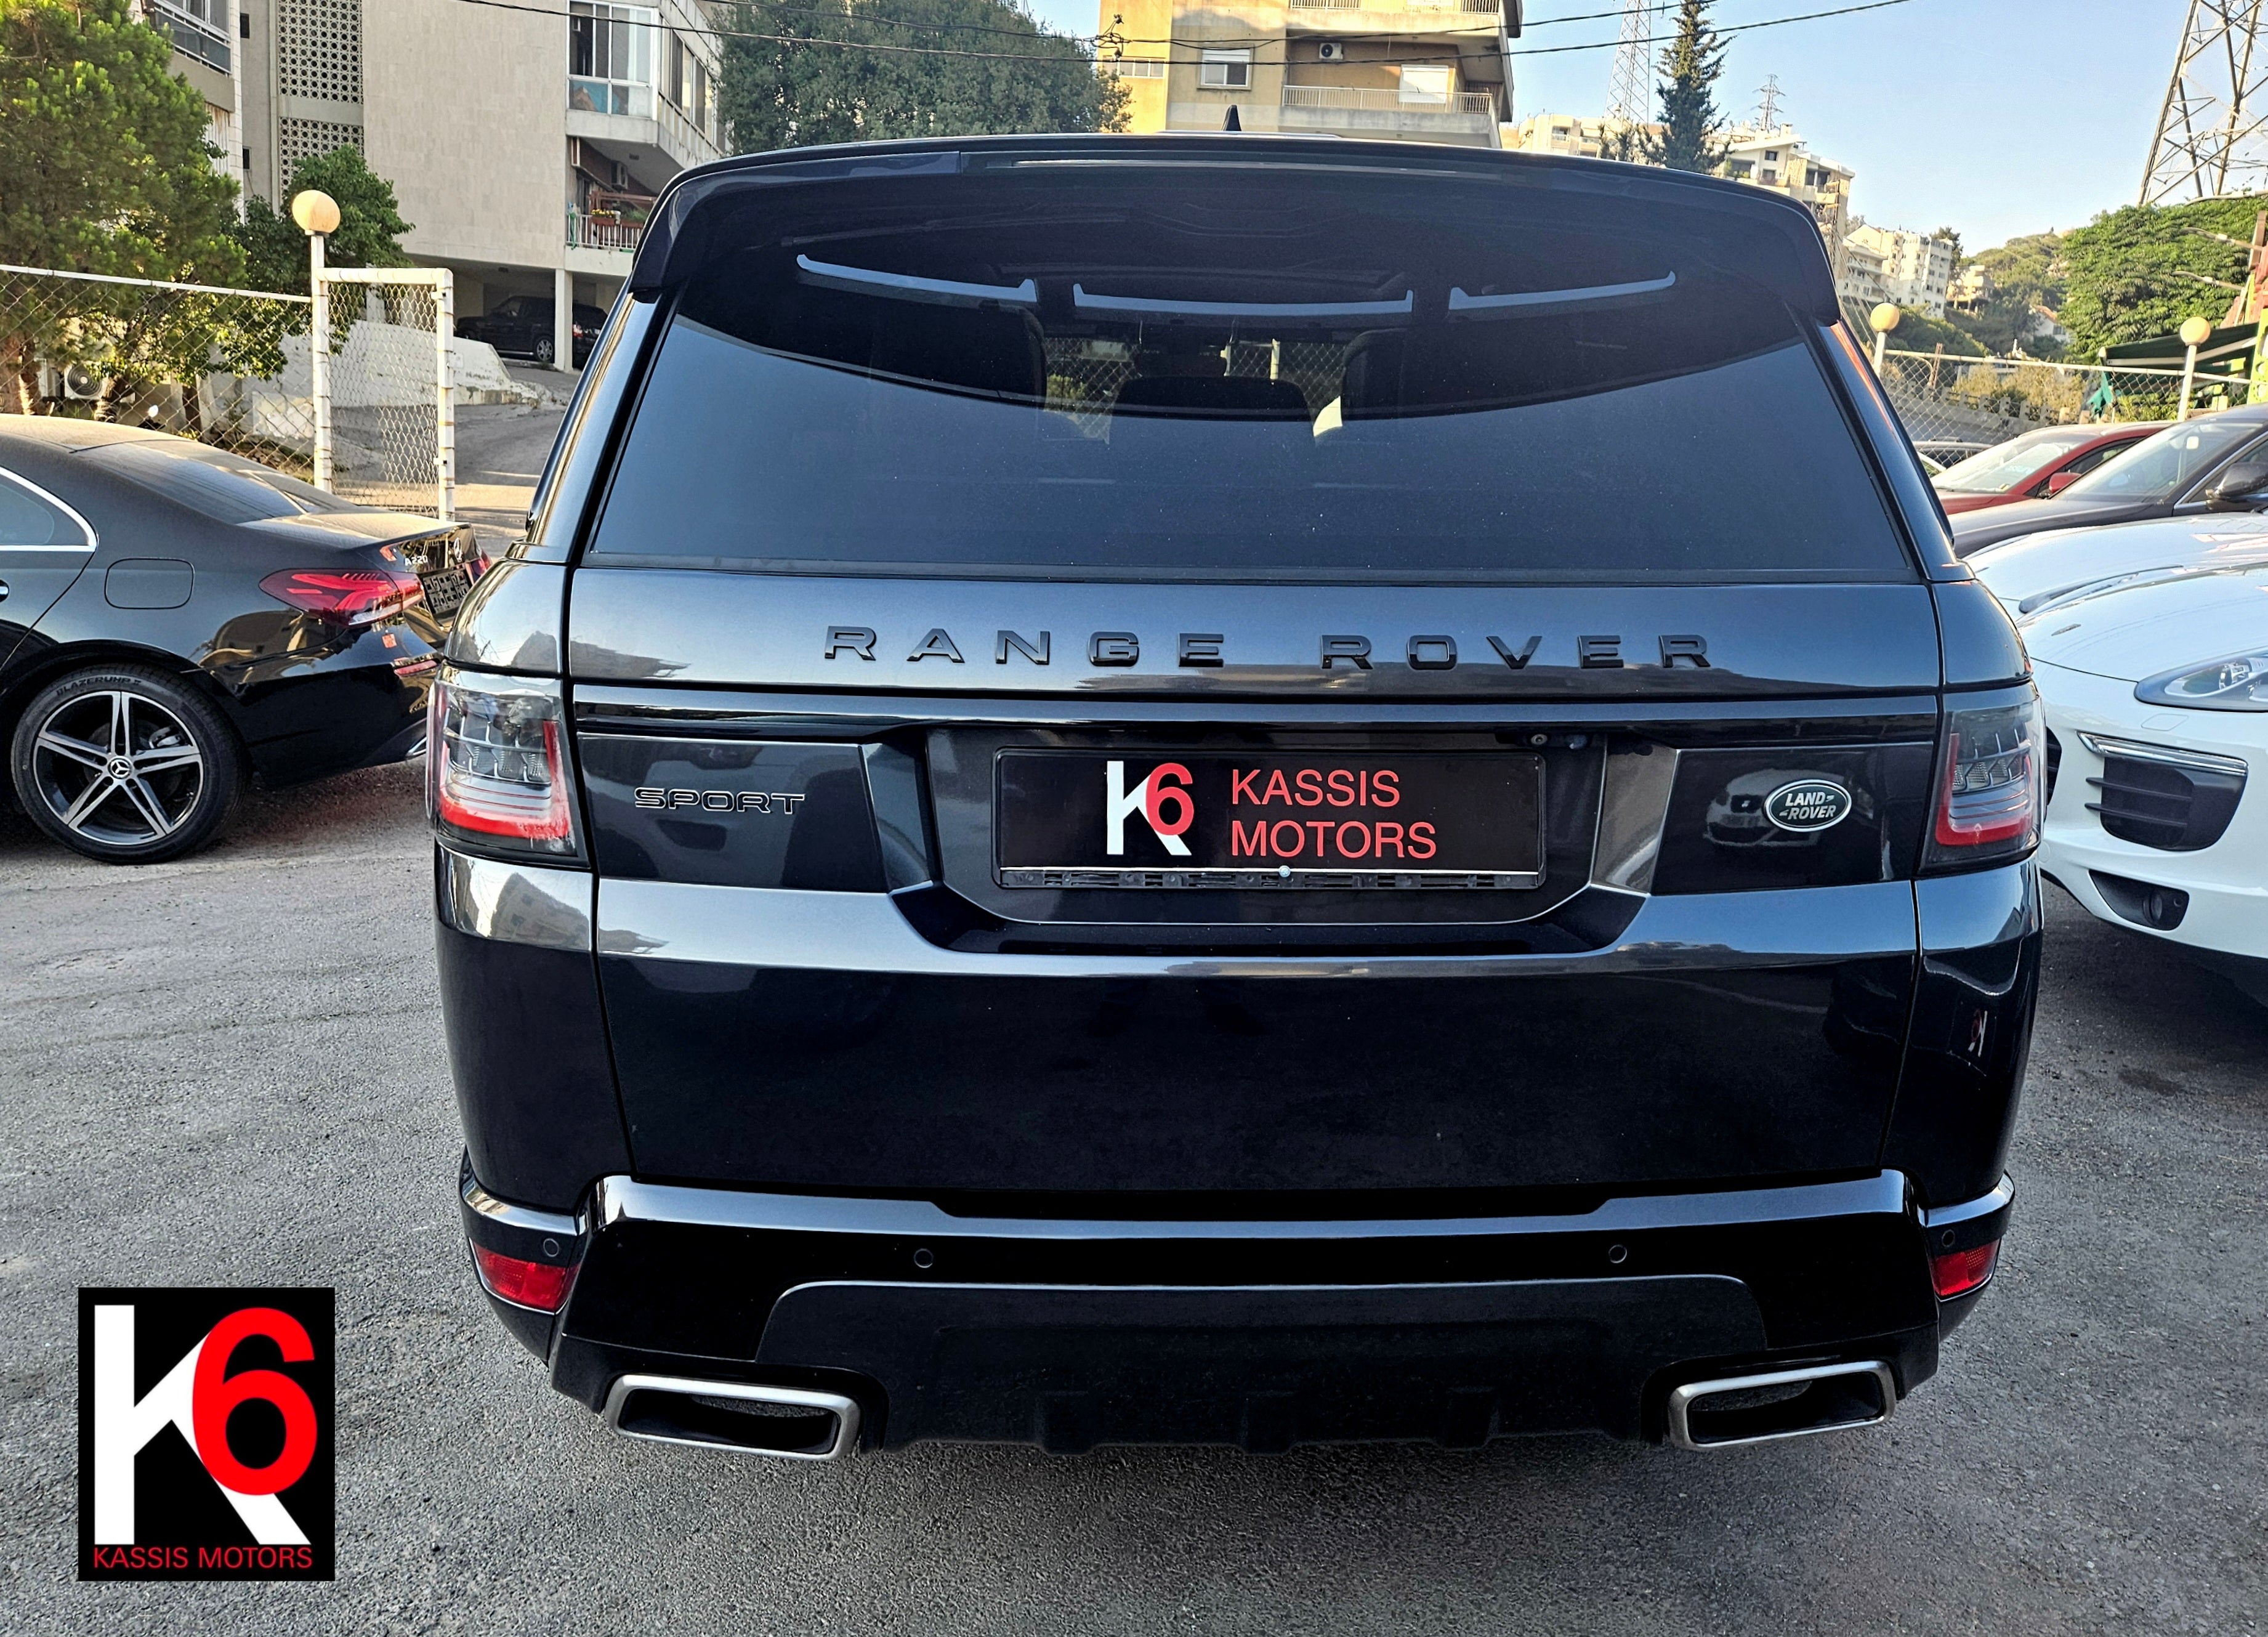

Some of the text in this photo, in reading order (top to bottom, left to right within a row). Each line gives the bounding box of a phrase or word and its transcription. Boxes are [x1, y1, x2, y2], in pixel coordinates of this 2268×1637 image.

[824, 625, 1711, 669] RANGE ROVER
[634, 786, 805, 814] SPORT
[1232, 769, 1400, 807] KASSIS
[1785, 792, 1825, 806] LAND
[1787, 805, 1836, 820] ROVER
[1232, 820, 1436, 859] MOTORS
